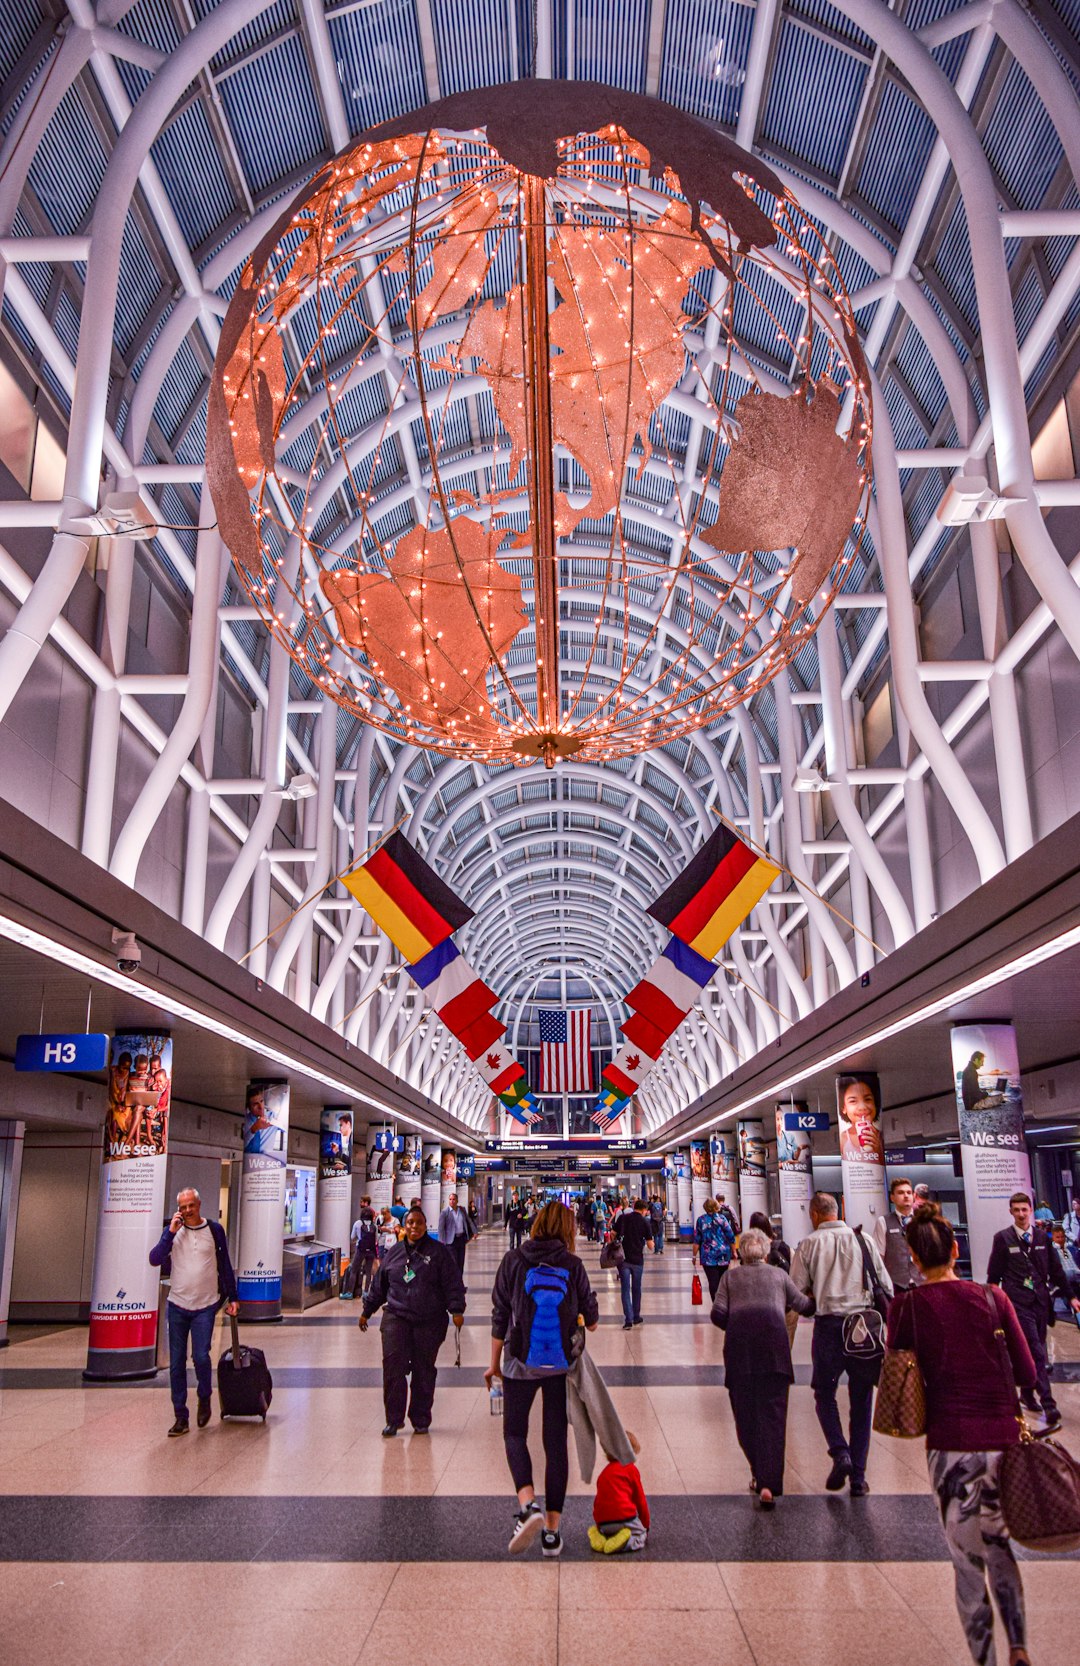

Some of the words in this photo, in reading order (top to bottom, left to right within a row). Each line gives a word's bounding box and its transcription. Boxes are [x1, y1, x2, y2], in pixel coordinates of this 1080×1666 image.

[44, 1042, 76, 1064] H3
[798, 1116, 816, 1128] K2
[970, 1132, 995, 1146] We
[997, 1134, 1019, 1145] see
[110, 1142, 131, 1155] We
[133, 1144, 156, 1155] see
[846, 1151, 862, 1160] We
[249, 1158, 264, 1168] We
[323, 1168, 336, 1176] We
[98, 1302, 146, 1310] EMERSON
